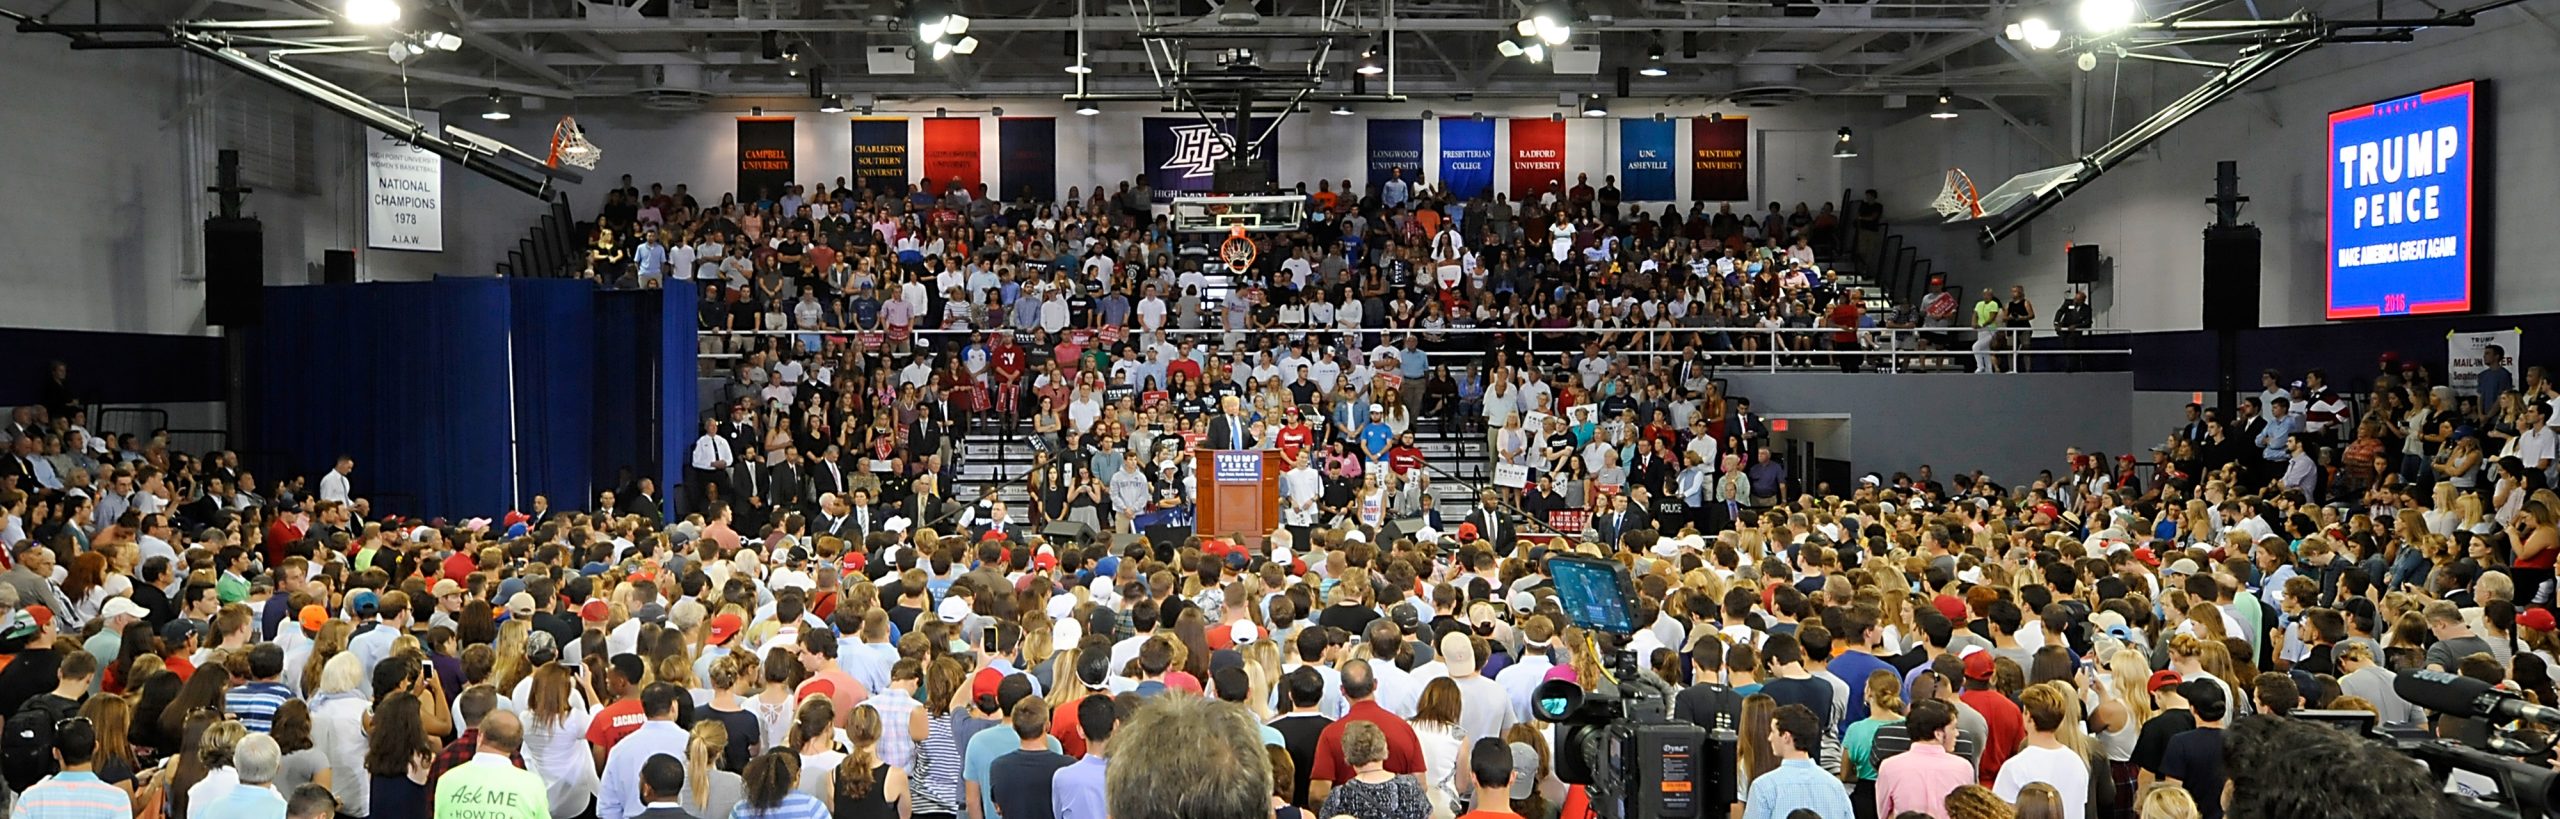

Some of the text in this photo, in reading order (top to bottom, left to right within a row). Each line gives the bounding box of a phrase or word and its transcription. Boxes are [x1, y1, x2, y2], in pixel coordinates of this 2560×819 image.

[854, 145, 905, 153] CHARLESTON
[384, 153, 403, 161] POINT
[745, 150, 786, 159] CAMPBELL
[1373, 150, 1419, 158] LONGWOOD
[1443, 150, 1492, 158] PRESBYTERIAN
[1519, 150, 1556, 158] RADFORD
[1639, 150, 1656, 158] UNC
[1699, 150, 1742, 158] WINTHROP
[2339, 126, 2458, 189] TRUMP
[742, 161, 789, 170] UNIVERSITY
[1452, 162, 1482, 170] COLLEGE
[1515, 162, 1560, 170] UNIVERSITY
[1696, 162, 1742, 170] UNIVERSITY
[379, 177, 430, 192] NATIONAL
[1154, 190, 1178, 198] HIGH
[375, 194, 436, 209] CHAMPIONS
[2353, 185, 2440, 229] PENCE
[395, 213, 416, 224] 1978
[2338, 247, 2361, 268] MAKE
[2361, 242, 2399, 265] AMERICA
[2399, 239, 2426, 262] GREAT
[2384, 293, 2406, 313] 2016
[1660, 503, 1682, 513] POLICE
[451, 784, 518, 807] Ask ME
[456, 809, 505, 819] HOW TO
